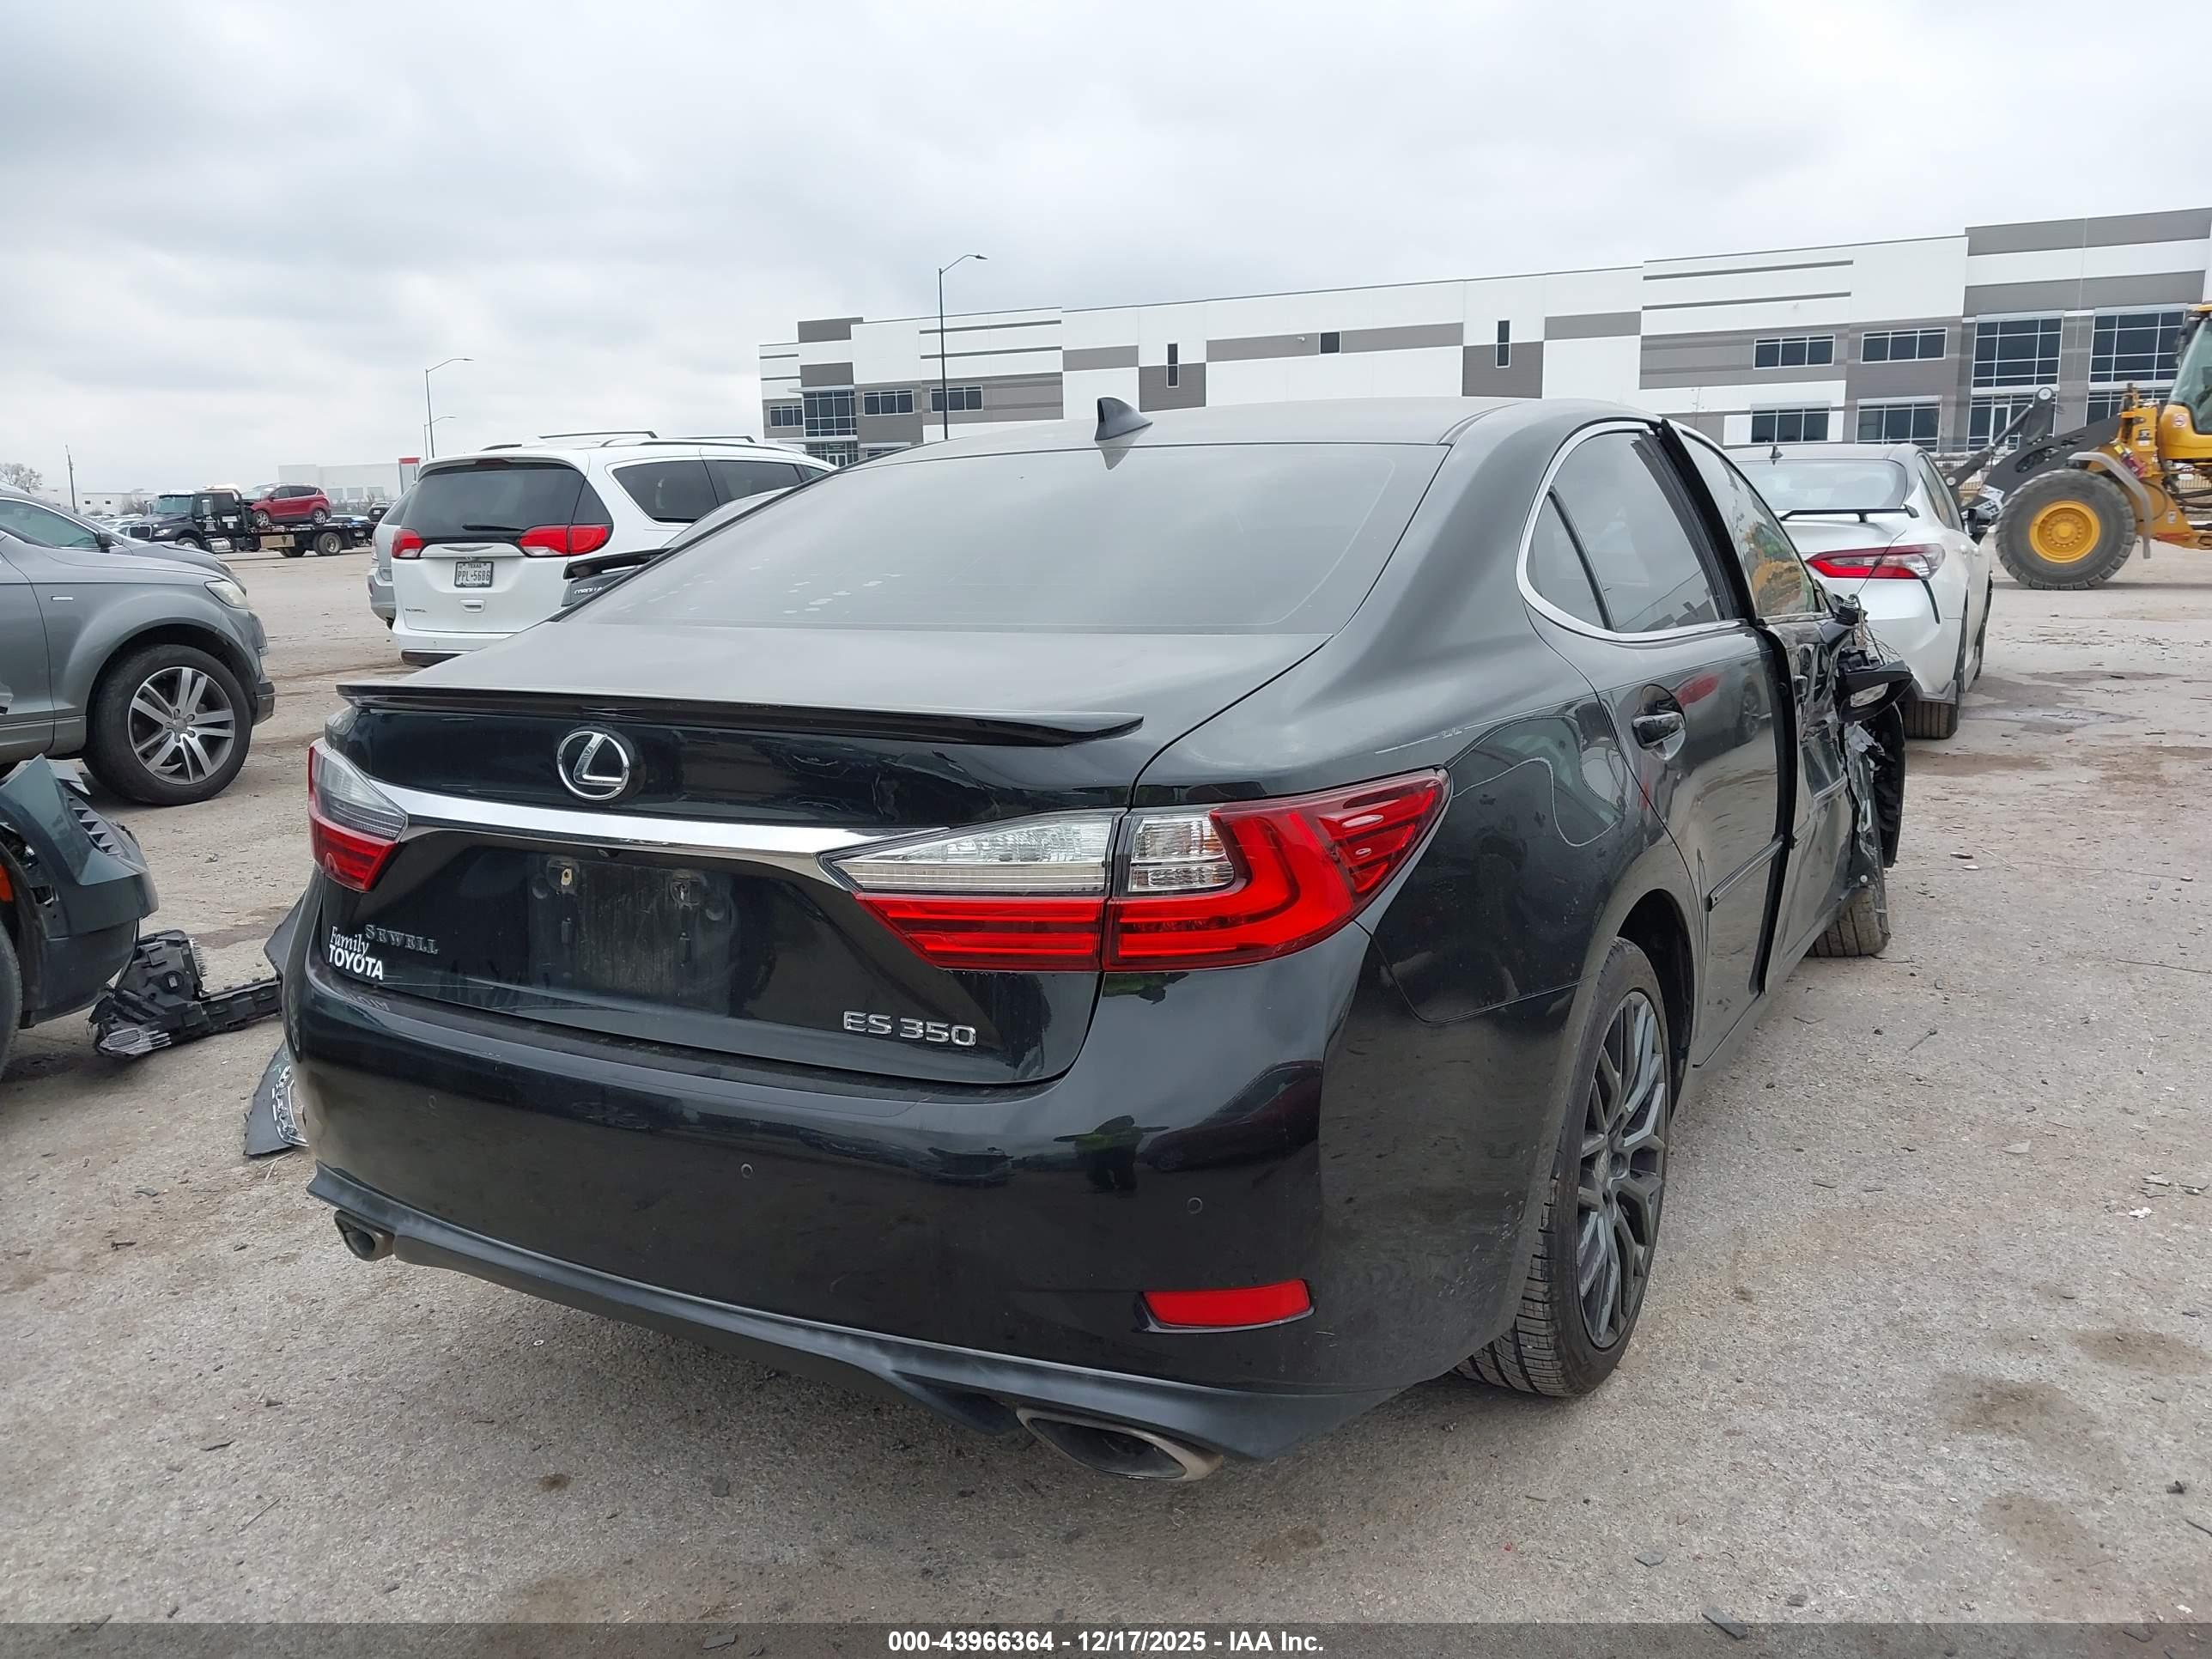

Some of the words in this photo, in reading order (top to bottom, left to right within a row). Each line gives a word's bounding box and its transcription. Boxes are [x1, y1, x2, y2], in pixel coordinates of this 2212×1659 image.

[329, 925, 369, 958] Family
[364, 923, 440, 955] SEWELL
[328, 944, 385, 981] TOYOTA
[842, 1010, 892, 1035] ES
[899, 1017, 977, 1048] 350
